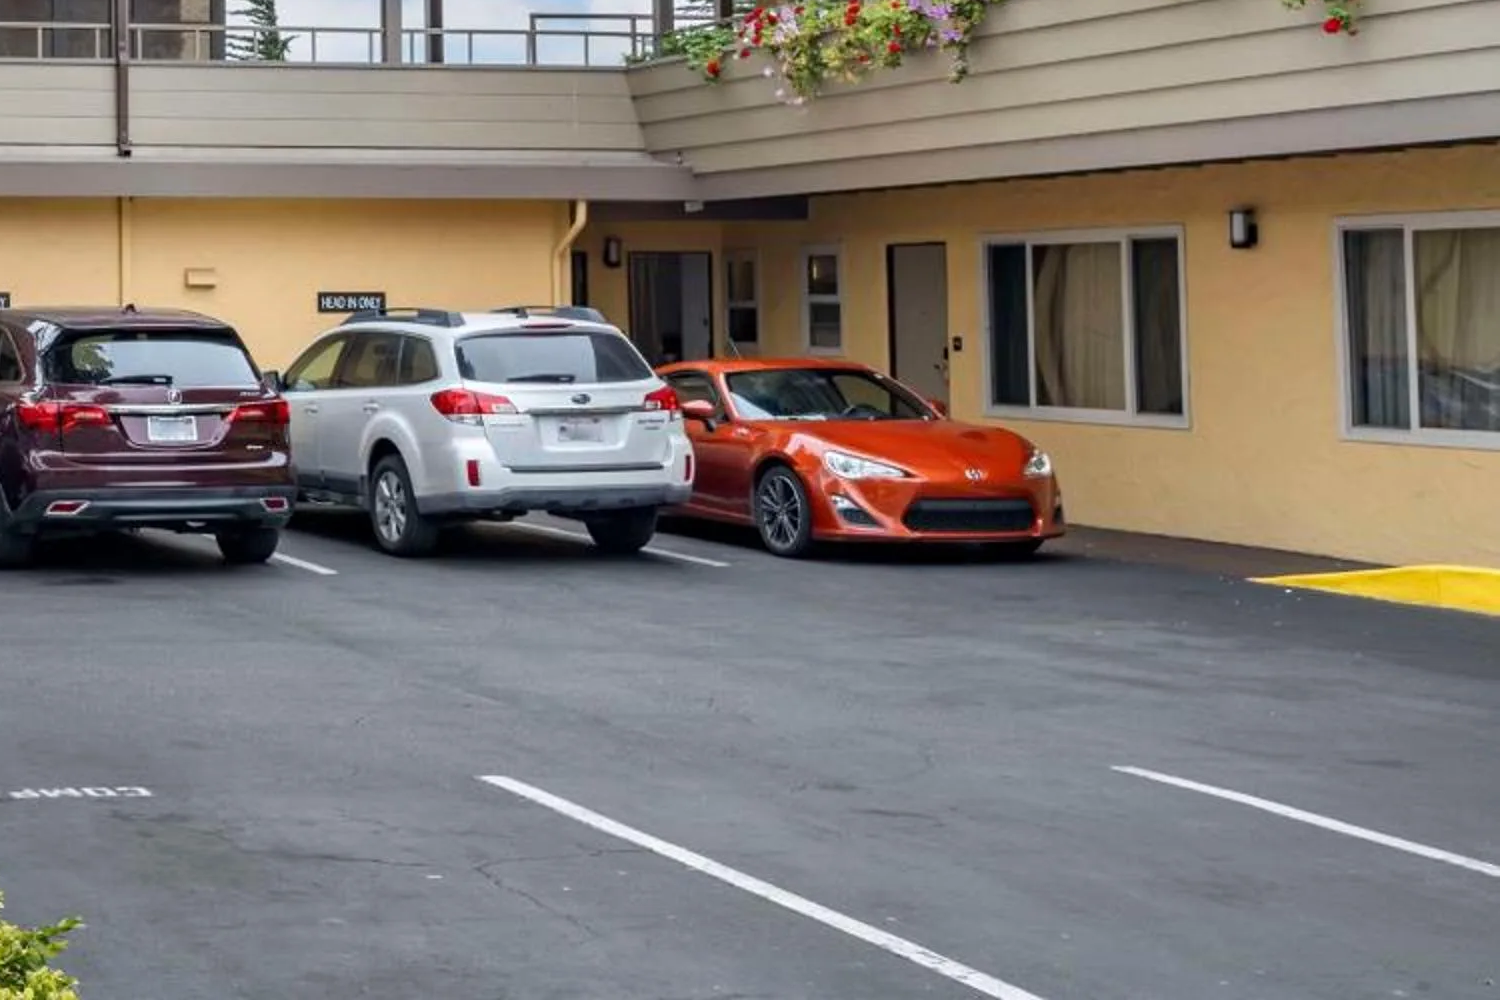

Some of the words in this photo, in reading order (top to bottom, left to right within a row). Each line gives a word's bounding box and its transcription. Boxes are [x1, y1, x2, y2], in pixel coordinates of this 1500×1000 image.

[321, 295, 345, 309] HEAD
[347, 295, 357, 309] IN
[358, 295, 381, 309] ONLY
